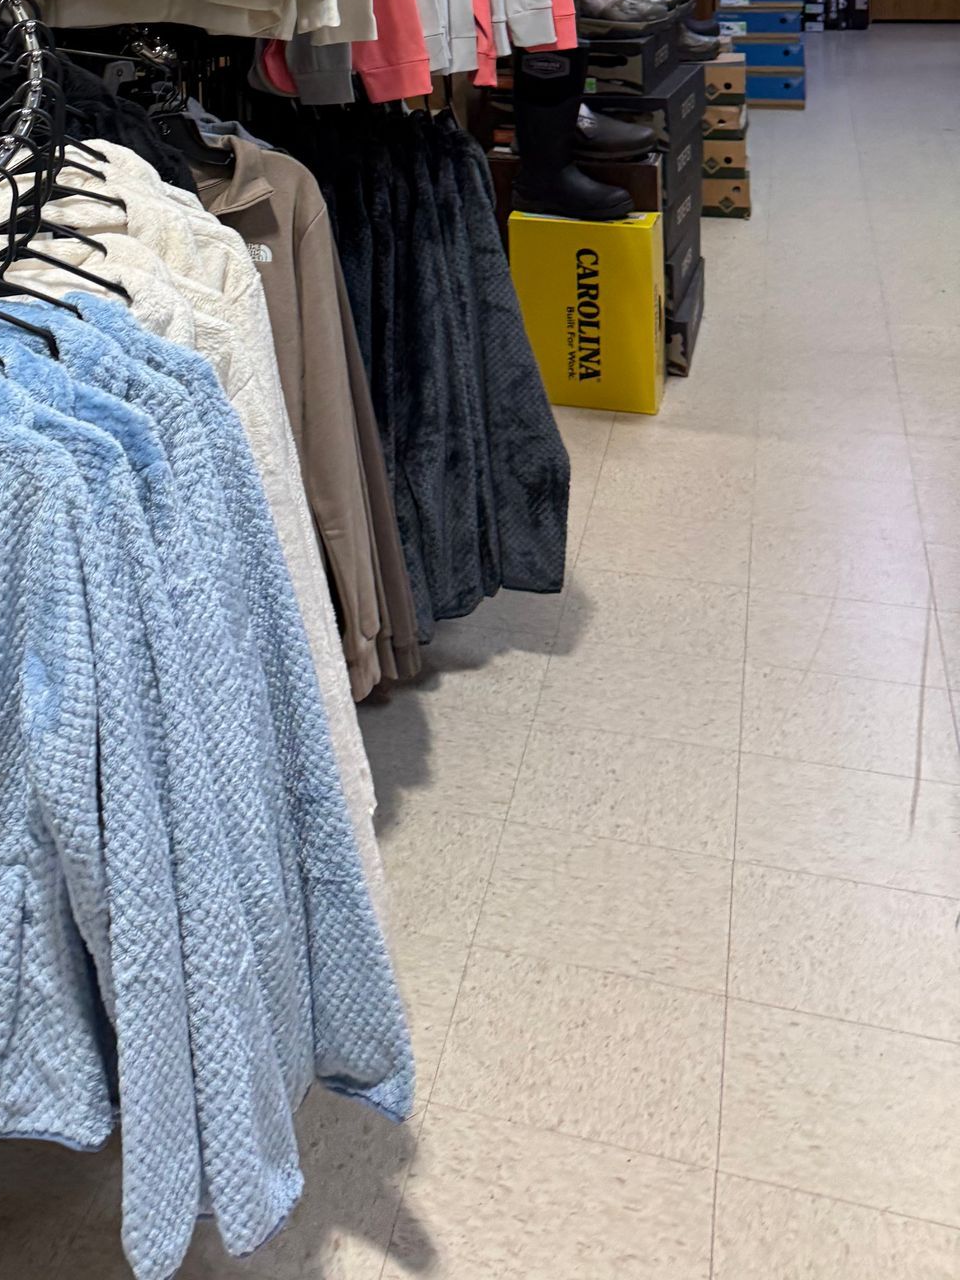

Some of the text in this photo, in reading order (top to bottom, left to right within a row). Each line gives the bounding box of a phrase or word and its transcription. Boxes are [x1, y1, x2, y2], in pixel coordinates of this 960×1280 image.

[566, 306, 576, 329] Built
[576, 248, 601, 382] CAROLINA
[567, 331, 576, 349] For
